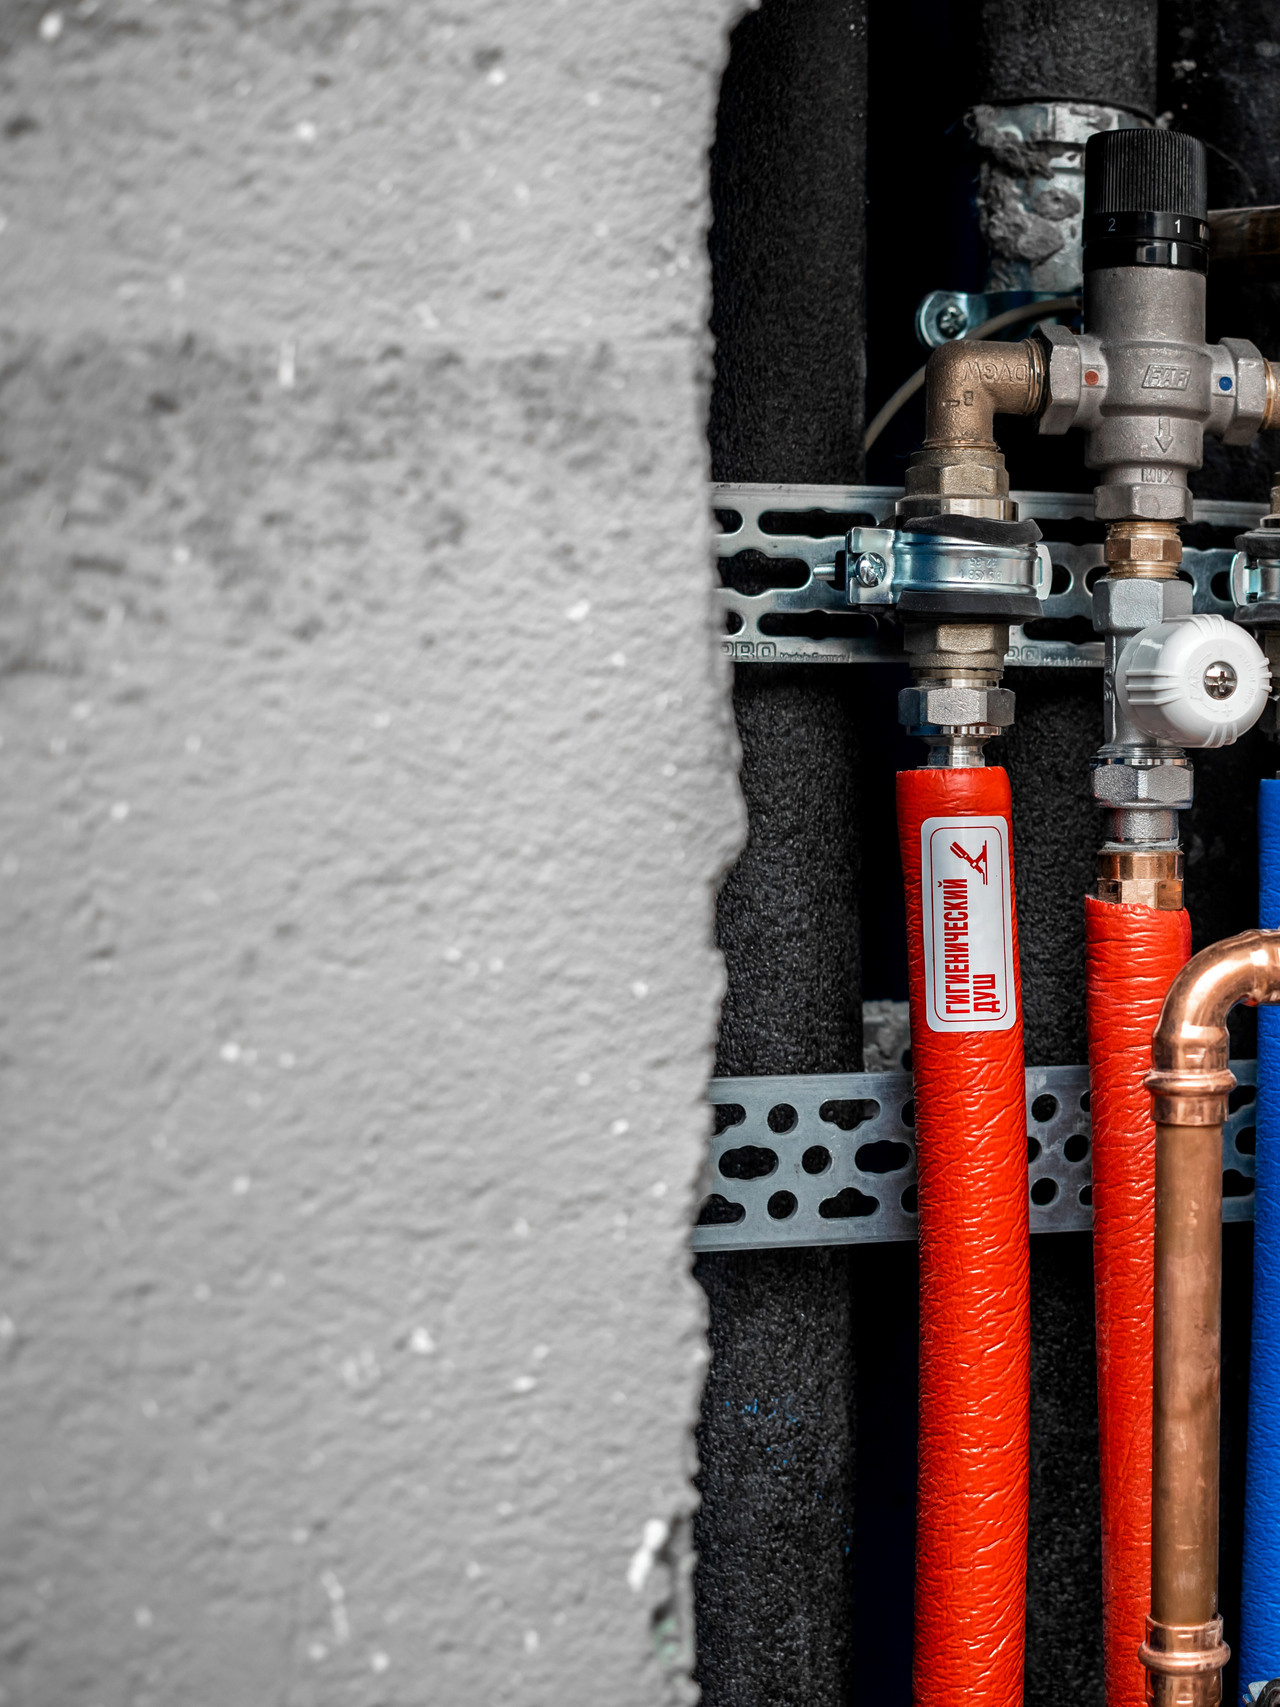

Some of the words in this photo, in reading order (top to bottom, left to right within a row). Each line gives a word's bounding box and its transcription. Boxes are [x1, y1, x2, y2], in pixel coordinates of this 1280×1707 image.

[1107, 217, 1116, 232] 2
[1174, 219, 1181, 234] 1
[1143, 364, 1191, 390] FAR
[1141, 468, 1173, 484] MIX
[937, 878, 971, 1014] ГИГИЕНИЧЕСКИЙ
[972, 973, 1001, 1013] ДУШ
